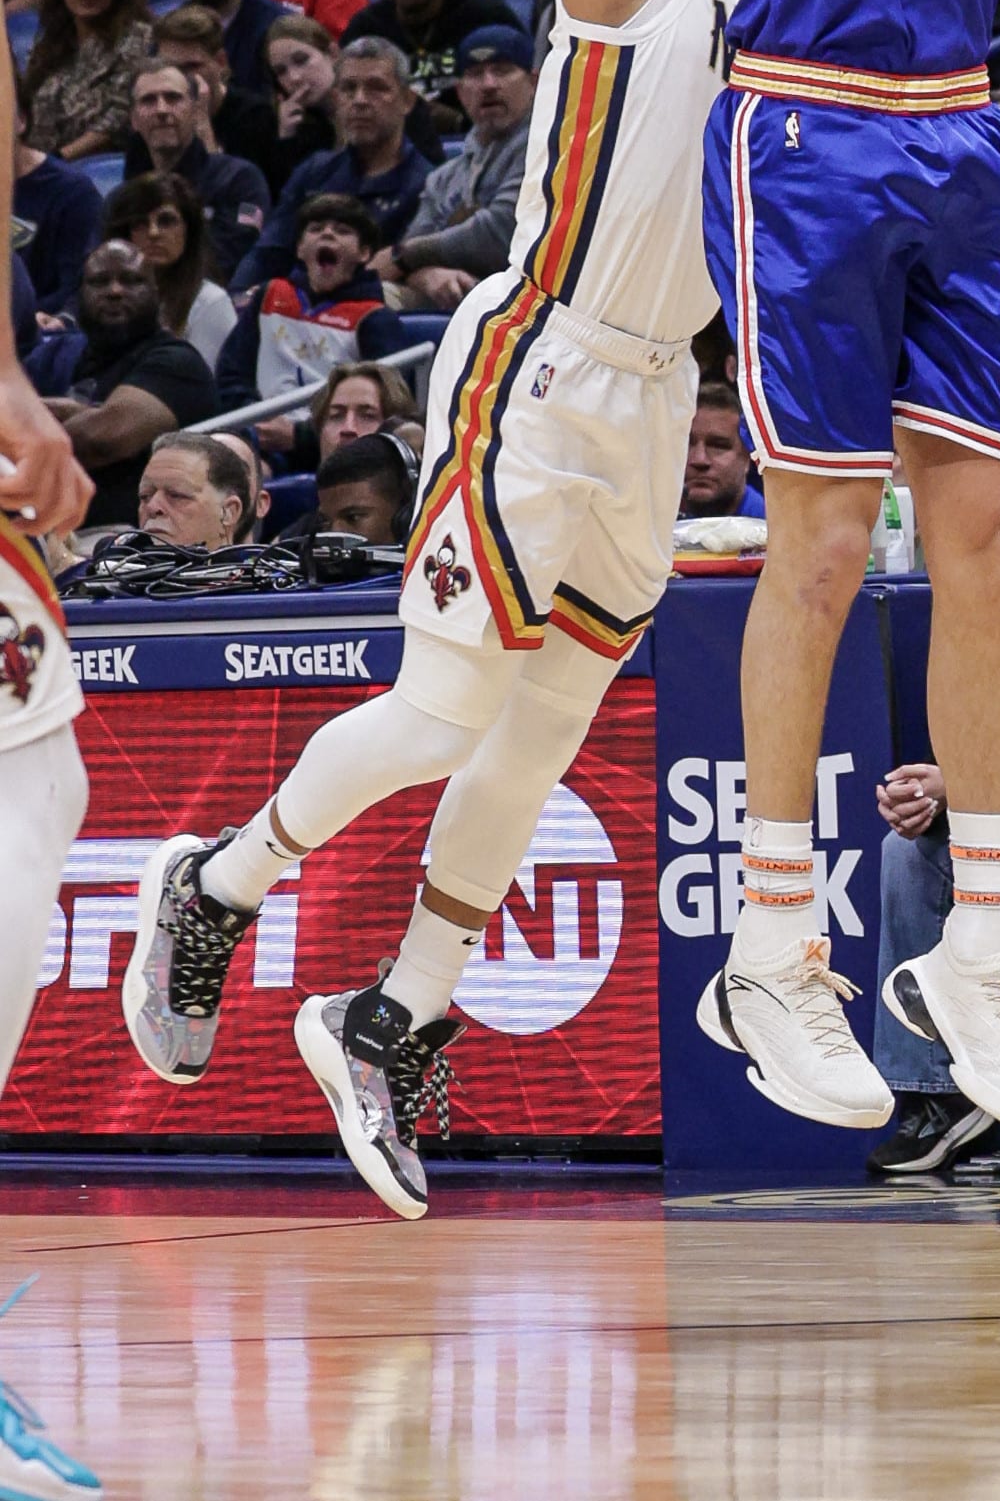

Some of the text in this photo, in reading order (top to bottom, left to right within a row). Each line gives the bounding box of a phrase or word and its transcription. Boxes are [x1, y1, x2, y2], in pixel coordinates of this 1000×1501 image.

[224, 639, 371, 681] SEATGEEK
[667, 753, 855, 845] SET
[659, 850, 865, 938] GEK
